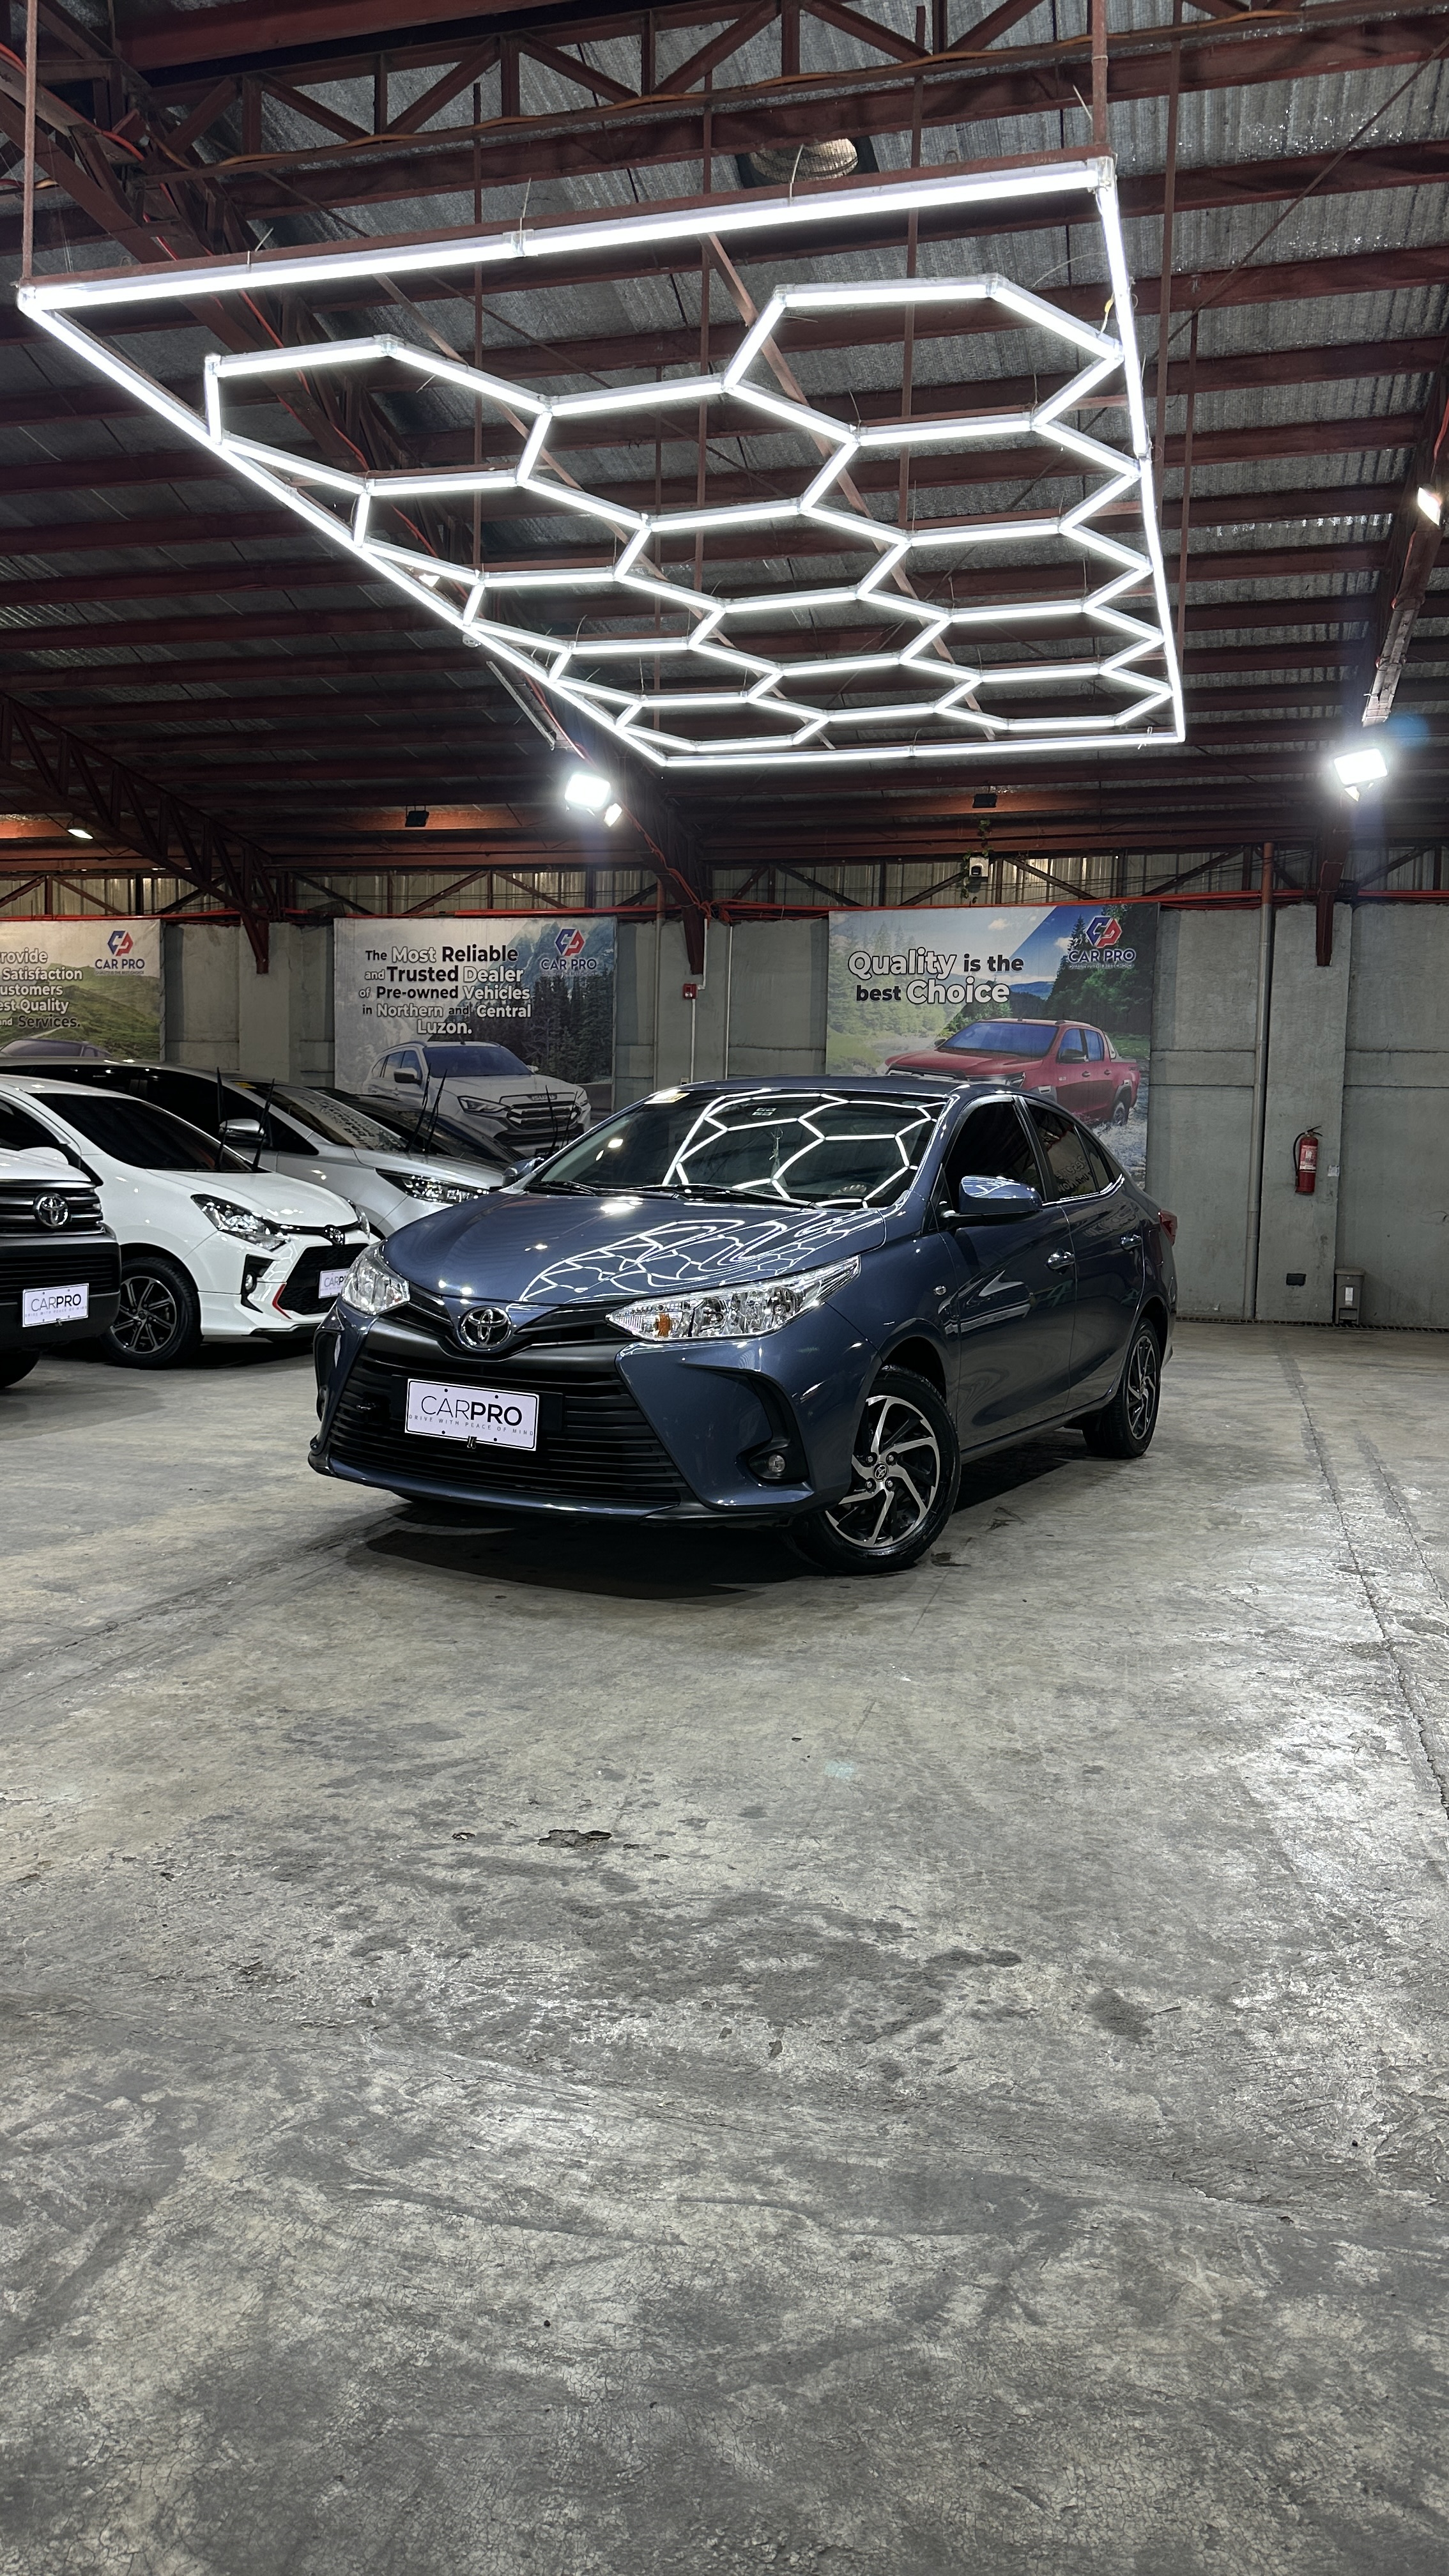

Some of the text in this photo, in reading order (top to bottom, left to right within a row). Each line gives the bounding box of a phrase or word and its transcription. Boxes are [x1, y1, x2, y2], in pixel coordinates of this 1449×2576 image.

[0, 947, 49, 963] rovide
[365, 944, 519, 963] The Most Reliable
[1068, 949, 1136, 963] CAR PRO
[95, 958, 145, 969] CAR PRO
[541, 958, 597, 970] CAR PRO
[848, 947, 1024, 979] Quality is the
[2, 965, 83, 981] Satisfaction
[365, 965, 524, 983] and Trusted Dealer
[0, 984, 63, 996] ustomers
[358, 985, 531, 1000] of Pre-owned Vehicles
[856, 976, 1009, 1004] best Choice
[20, 997, 69, 1014] Quality
[362, 1003, 532, 1018] in Northern and Central
[19, 1014, 80, 1027] Services.
[417, 1019, 472, 1034] Luzon.
[324, 1275, 346, 1287] CARP
[31, 1294, 81, 1312] CARPRO
[421, 1395, 523, 1426] CARPRO
[409, 1414, 433, 1422] DRIVE
[465, 1422, 491, 1430] PEACE
